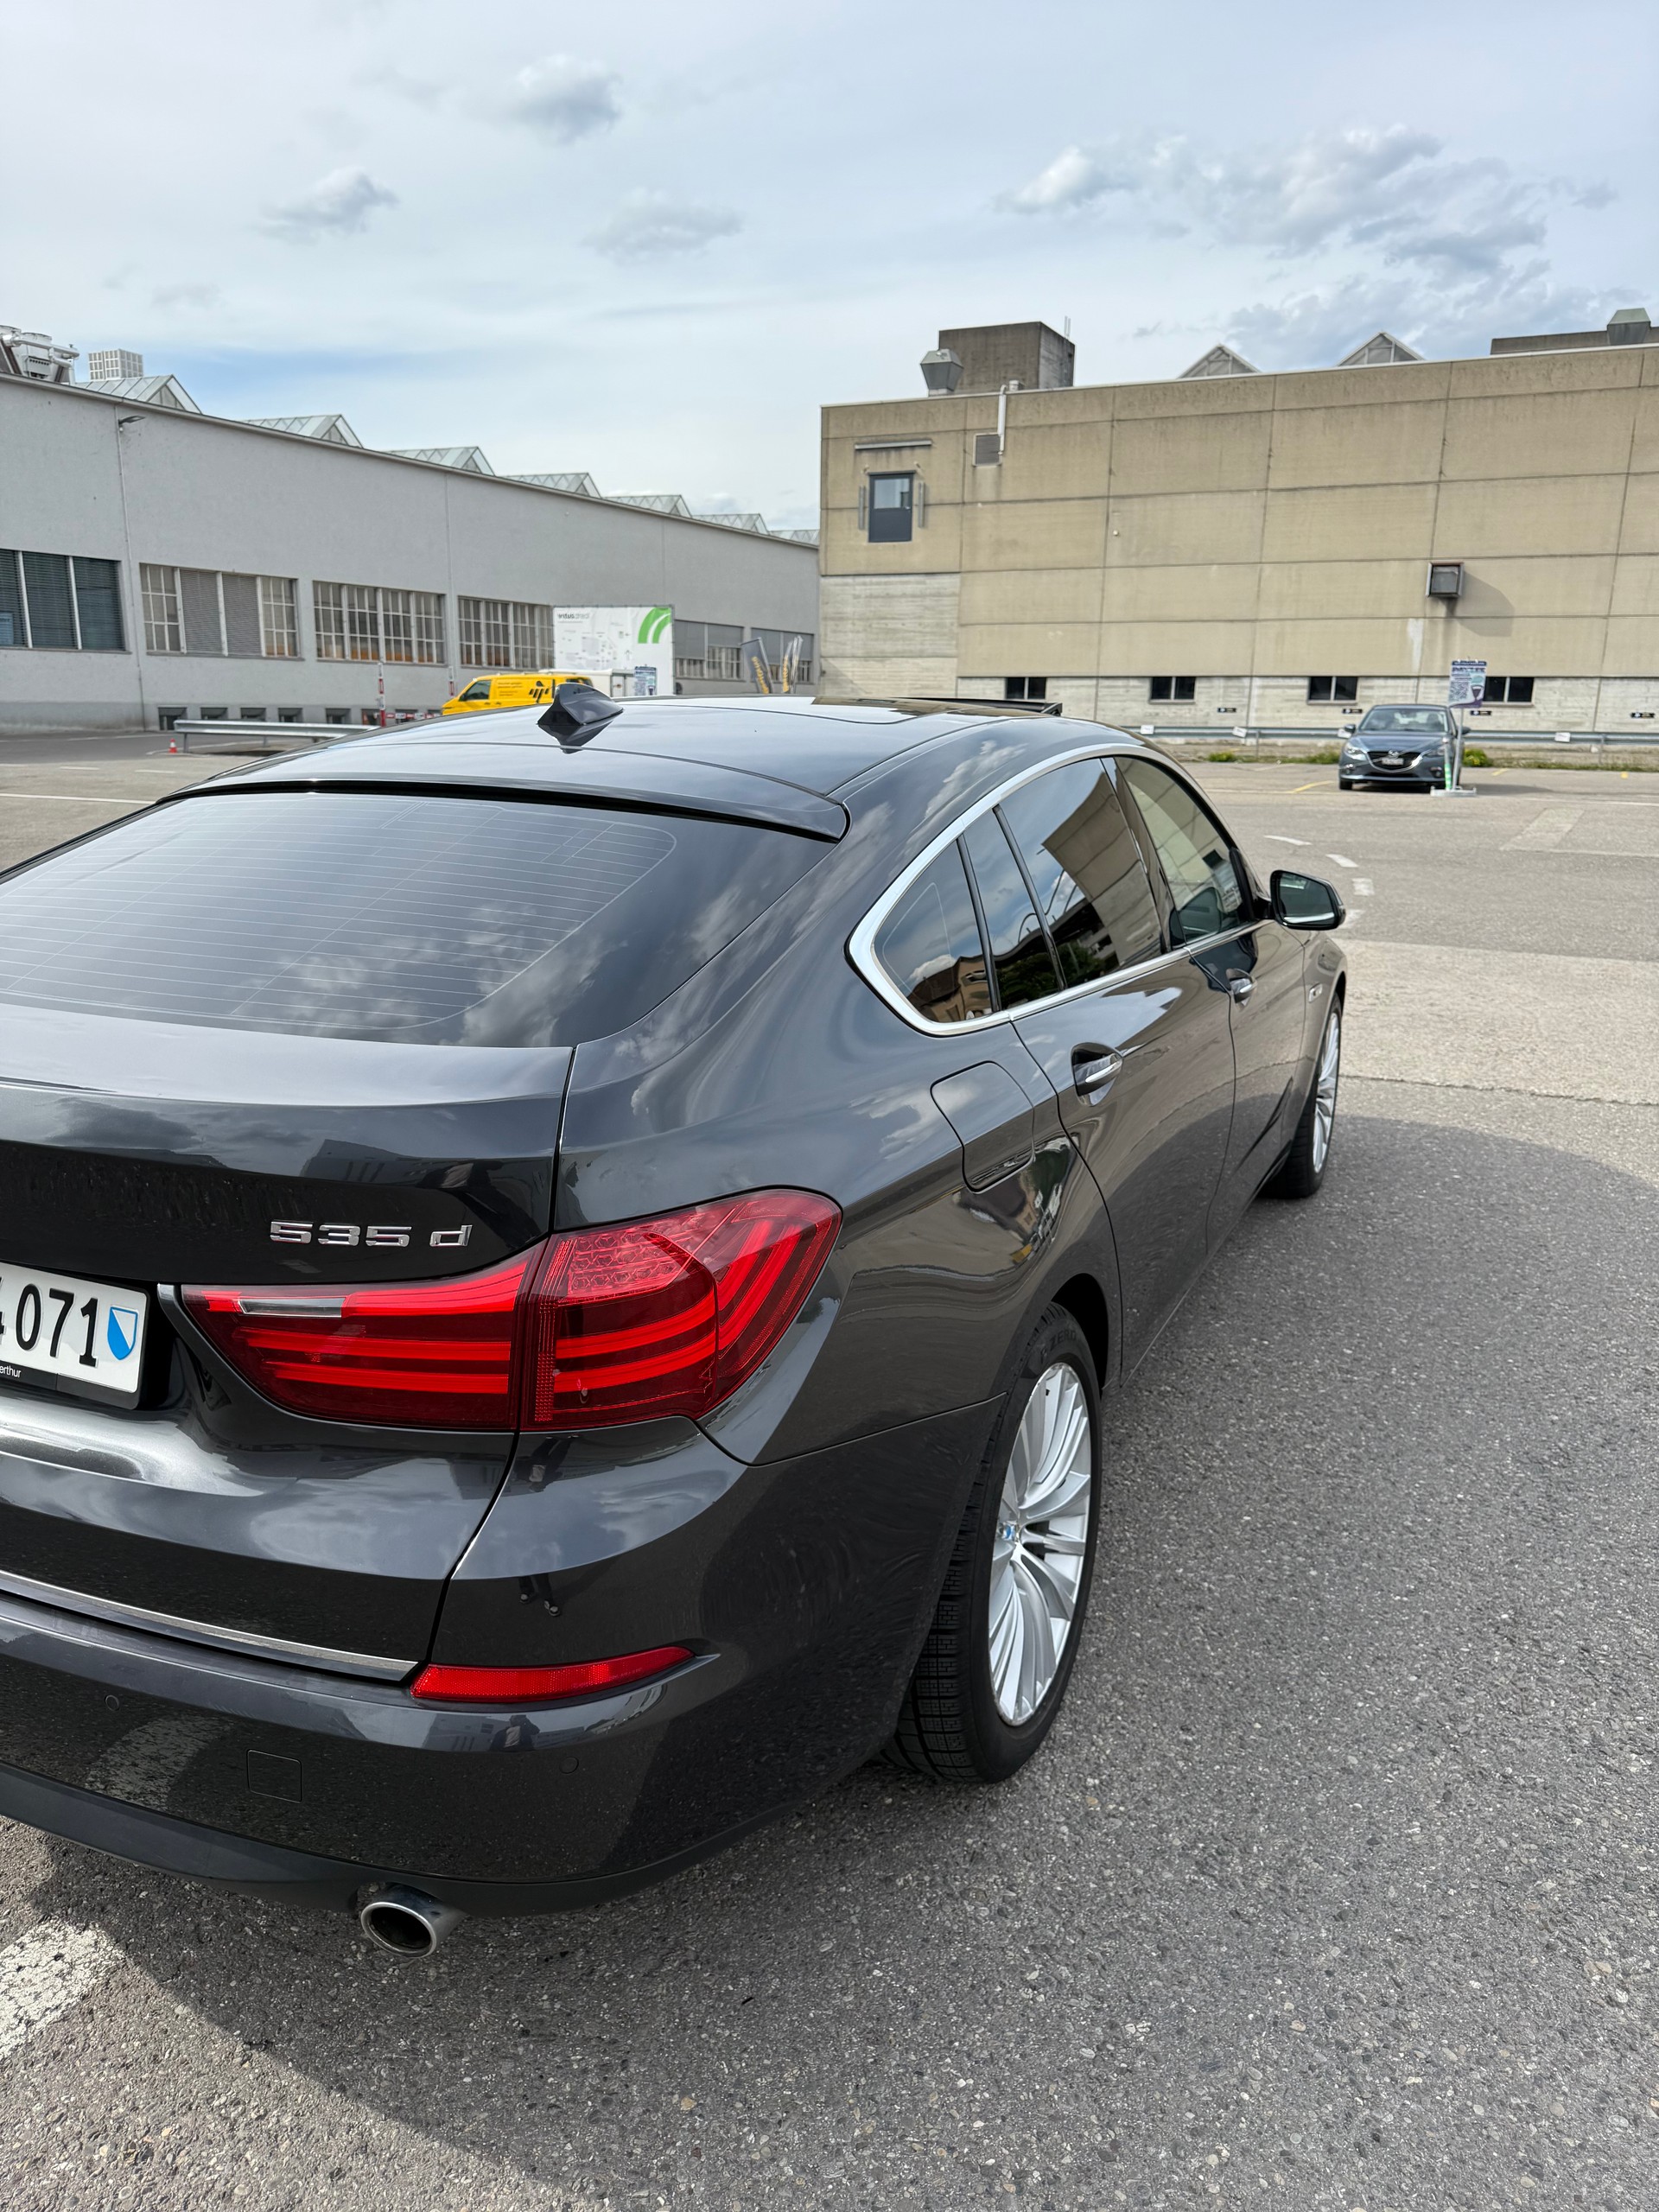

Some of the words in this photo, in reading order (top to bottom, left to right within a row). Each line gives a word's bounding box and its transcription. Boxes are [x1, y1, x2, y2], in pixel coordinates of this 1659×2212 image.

[270, 1221, 412, 1248] 535
[429, 1224, 473, 1247] d
[0, 1276, 99, 1369] 071
